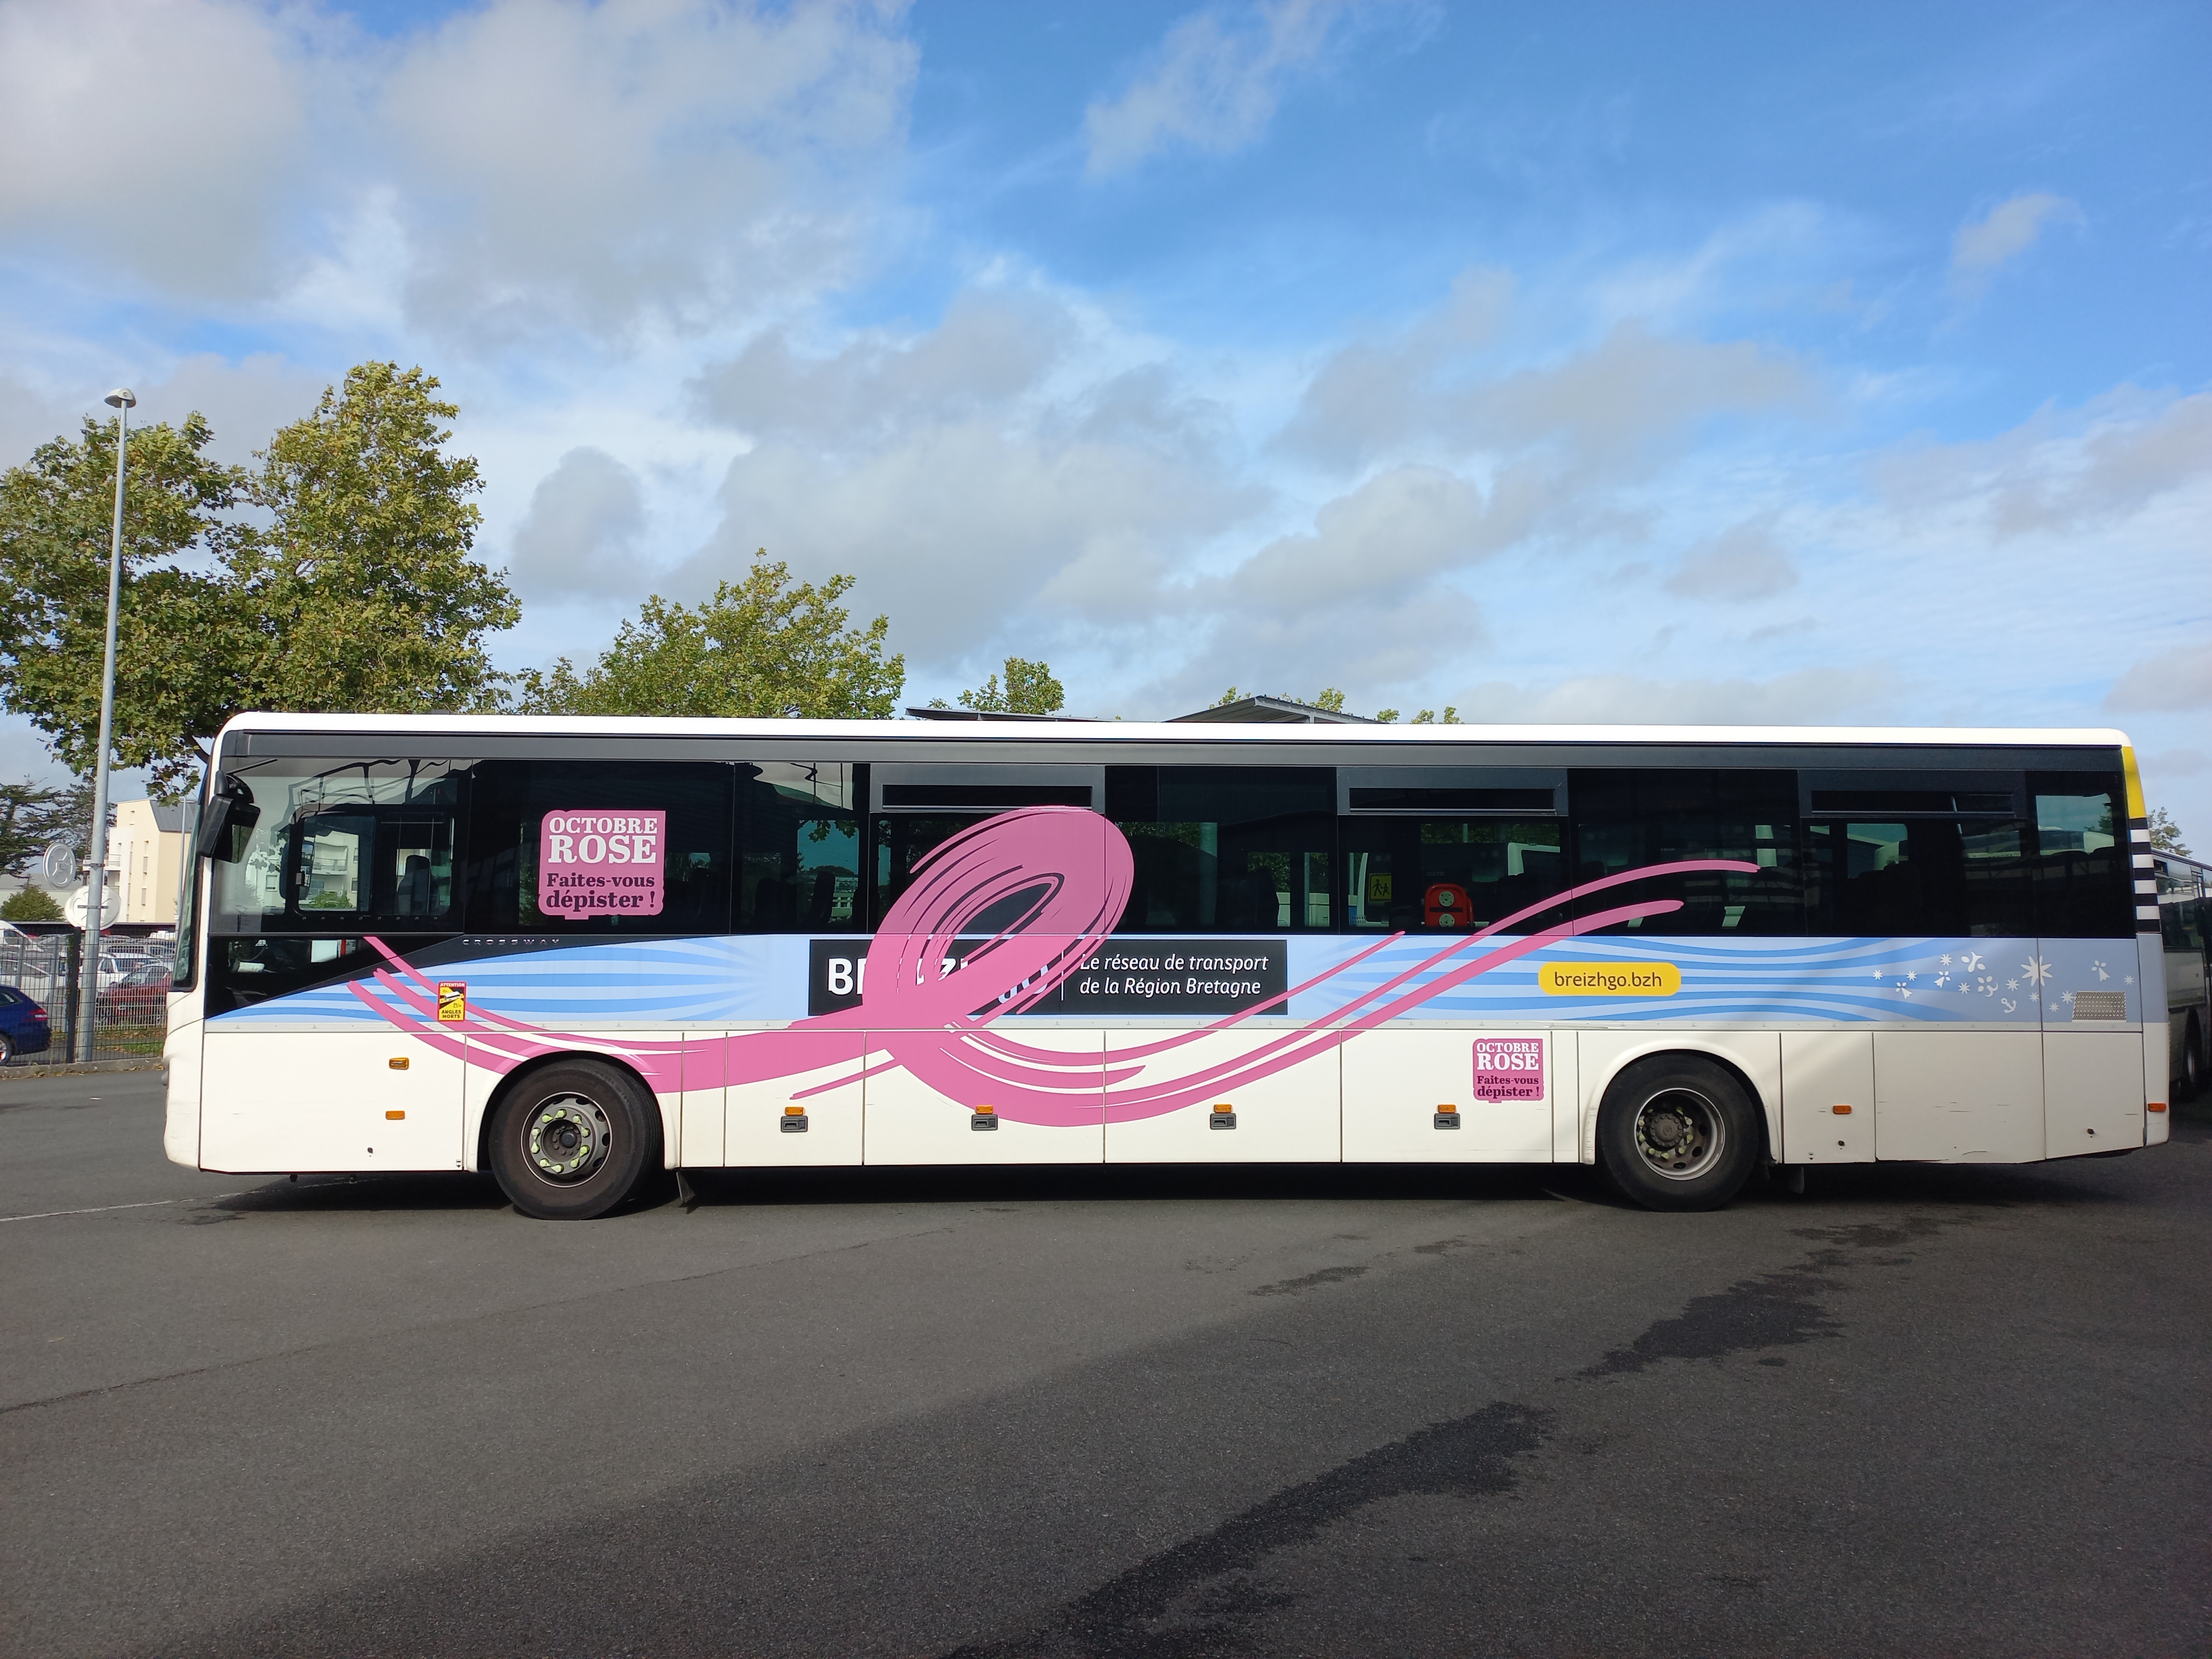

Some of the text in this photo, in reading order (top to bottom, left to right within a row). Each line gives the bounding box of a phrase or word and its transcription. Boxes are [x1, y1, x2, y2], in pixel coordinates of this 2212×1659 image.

[549, 817, 657, 834] OCTOBRE
[548, 834, 656, 864] ROSE
[546, 872, 655, 887] Faites-vous
[546, 889, 644, 912] dépister
[1080, 953, 1269, 974] Le réseau de transport
[1080, 977, 1261, 998] de la Région Bretagne
[1554, 971, 1662, 991] breizhgo.bzh
[1476, 1042, 1539, 1052] OCTOBRE
[1477, 1053, 1539, 1071] ROSE
[1477, 1075, 1539, 1084] Faites-vous
[1477, 1085, 1533, 1099] dépister
